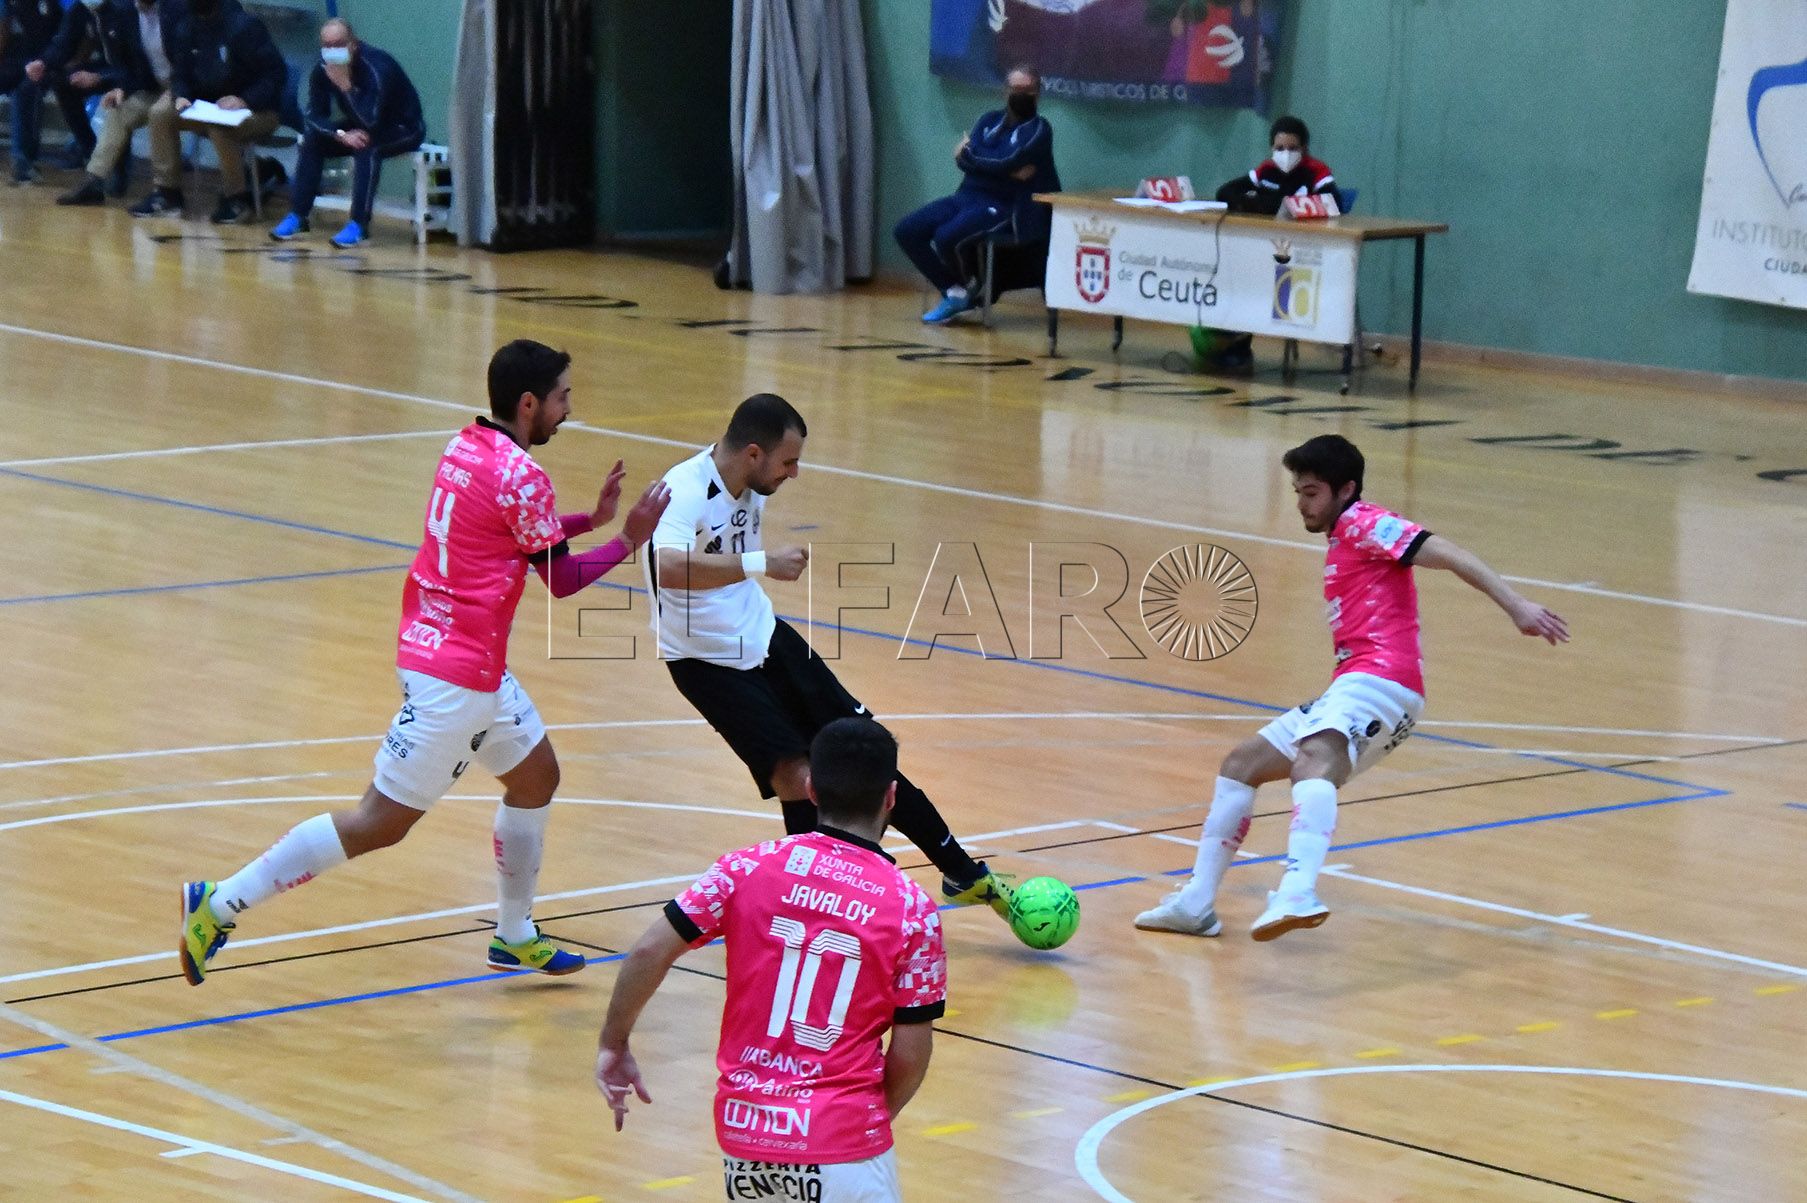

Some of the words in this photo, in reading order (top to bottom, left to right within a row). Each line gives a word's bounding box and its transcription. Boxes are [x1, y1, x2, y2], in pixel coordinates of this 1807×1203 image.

[1139, 270, 1218, 307] Ceuta
[813, 865, 830, 880] DE
[831, 870, 887, 897] GALICIA
[818, 853, 865, 876] XUNTA
[781, 883, 877, 926] JAVALOY
[766, 915, 862, 1052] 10
[739, 1045, 824, 1078] ABANCA
